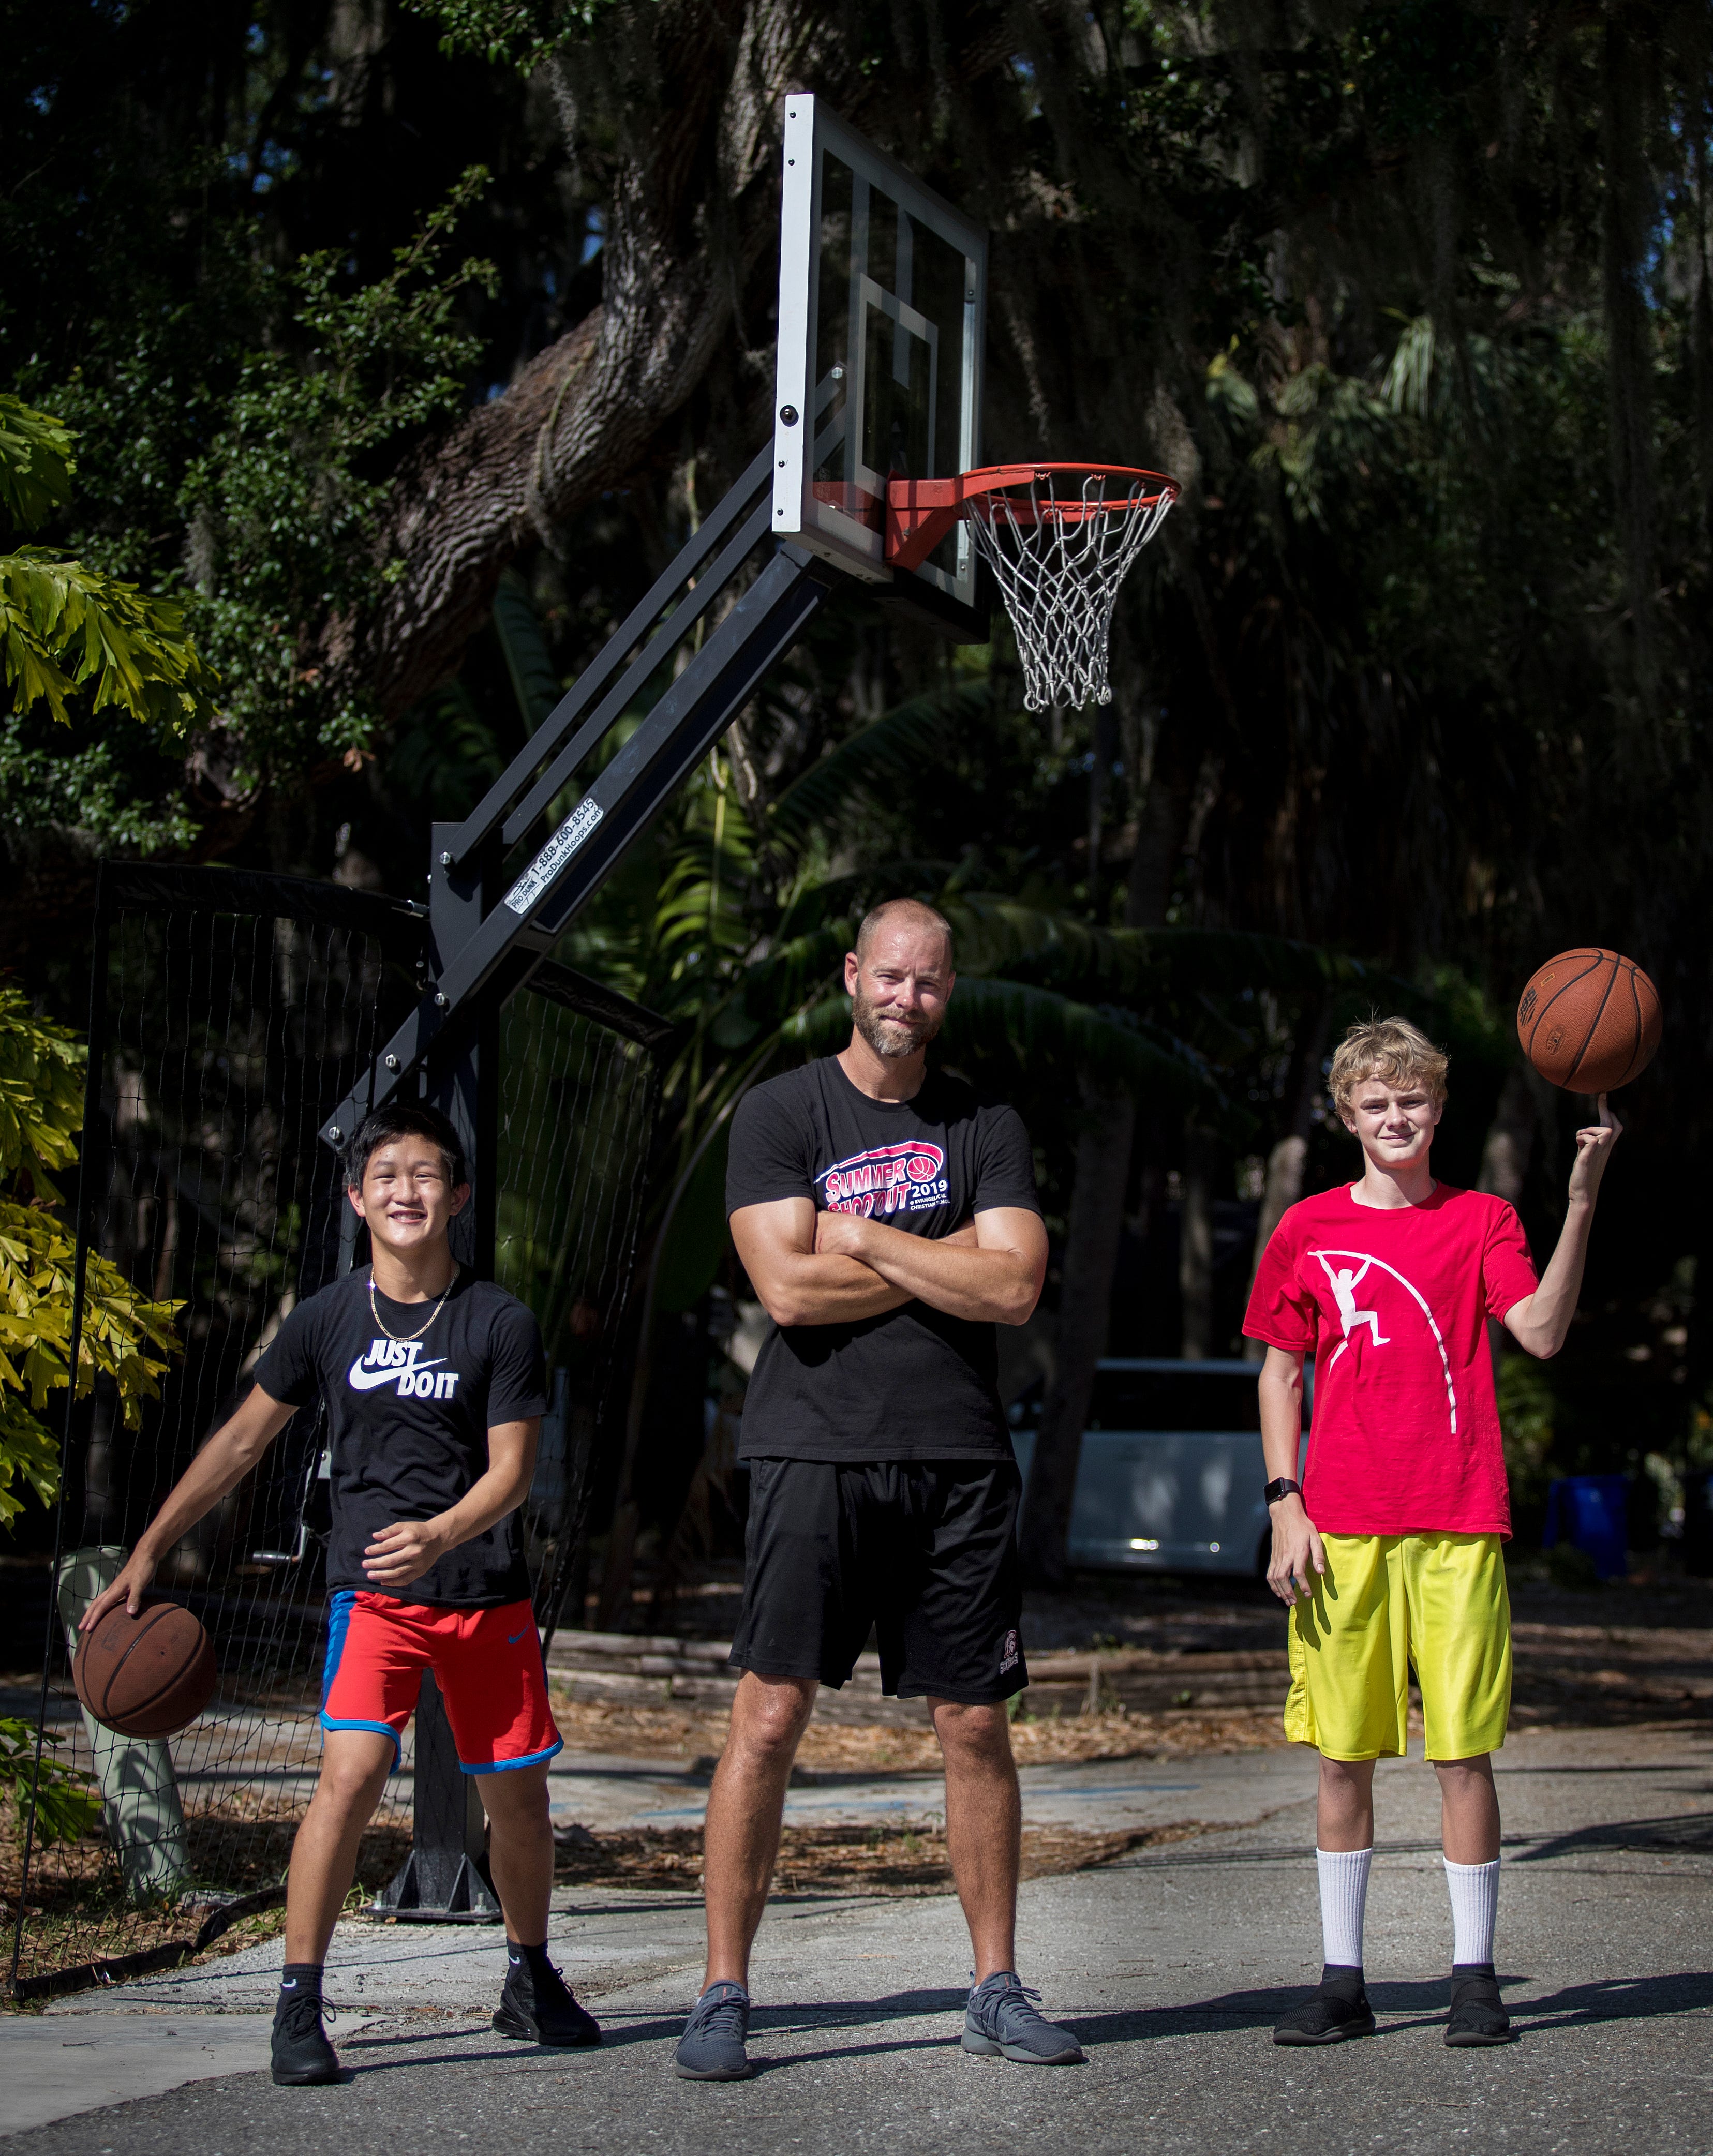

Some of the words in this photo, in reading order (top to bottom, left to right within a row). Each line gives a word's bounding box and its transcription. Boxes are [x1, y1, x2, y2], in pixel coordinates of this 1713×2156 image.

[531, 799, 594, 876] 1-888-600-8545
[511, 895, 524, 909] PRO
[522, 878, 538, 897] DUNK
[826, 1158, 907, 1203] SUMMER
[911, 1180, 948, 1198] 2019
[911, 1202, 935, 1210] CHRISTIAN
[915, 1194, 946, 1204] EVANGELICAL
[364, 1339, 423, 1368] JUST
[397, 1371, 434, 1398] DO
[434, 1372, 459, 1399] IT
